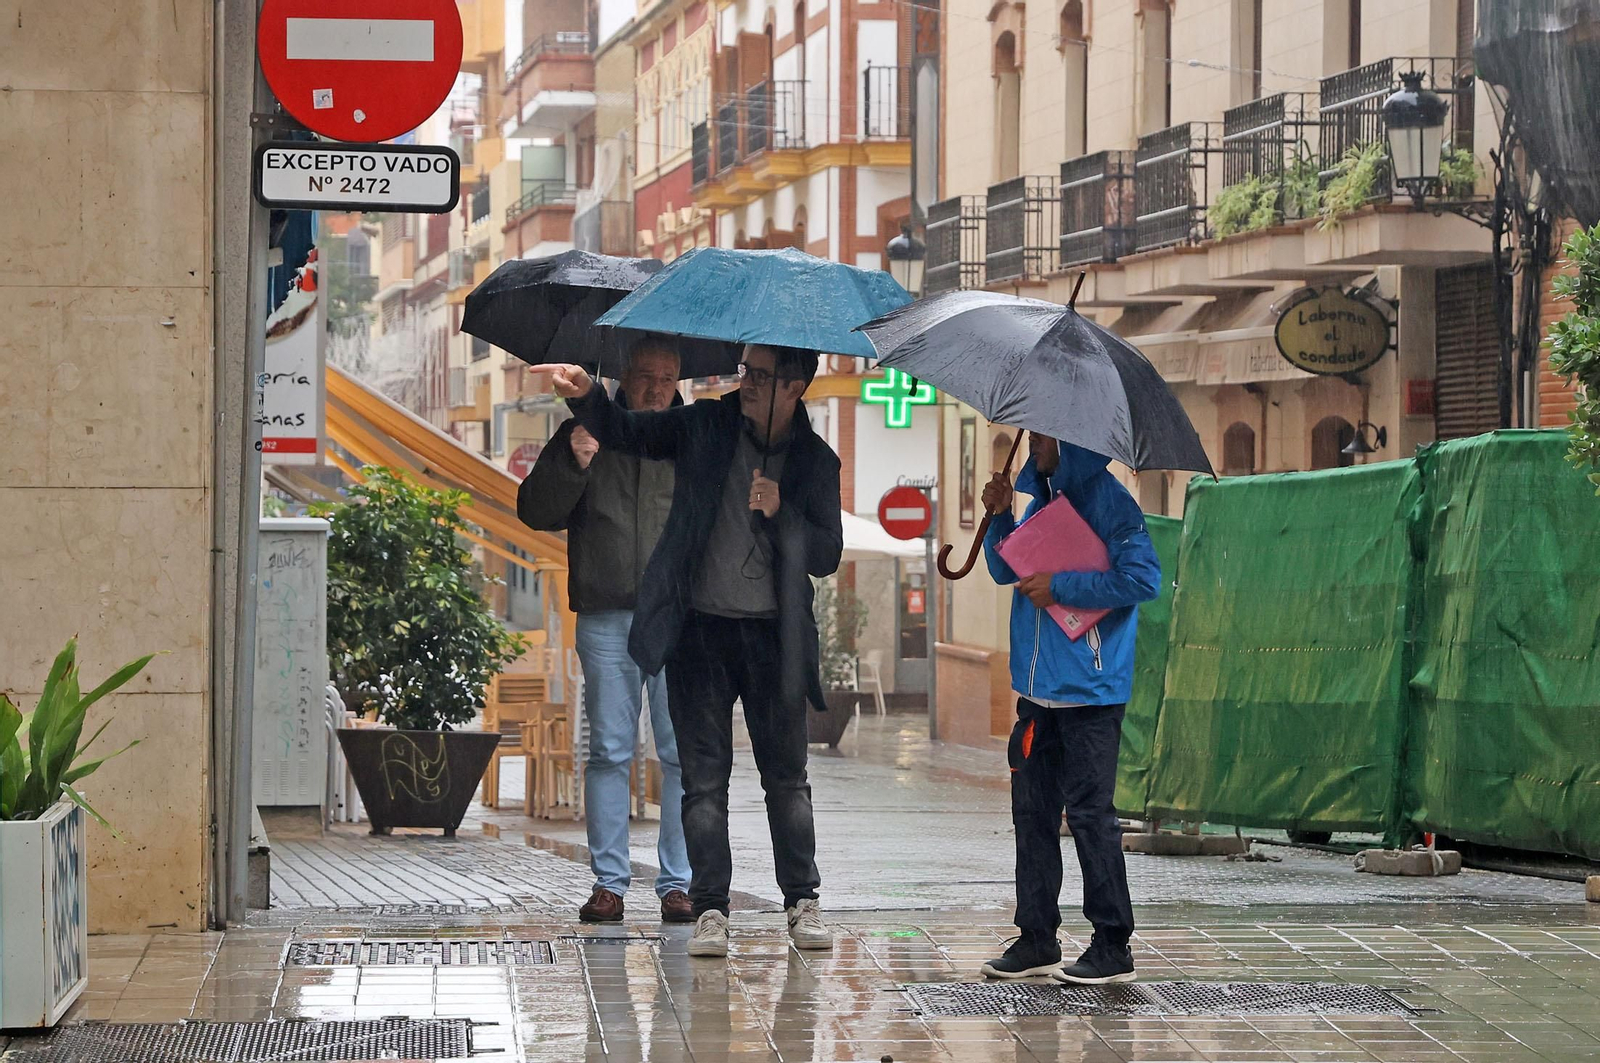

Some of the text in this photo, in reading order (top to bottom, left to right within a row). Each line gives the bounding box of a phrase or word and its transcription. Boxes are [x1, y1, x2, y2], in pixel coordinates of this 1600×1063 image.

[266, 153, 450, 174] EXCEPTO VADO
[308, 175, 391, 194] Nº 2472
